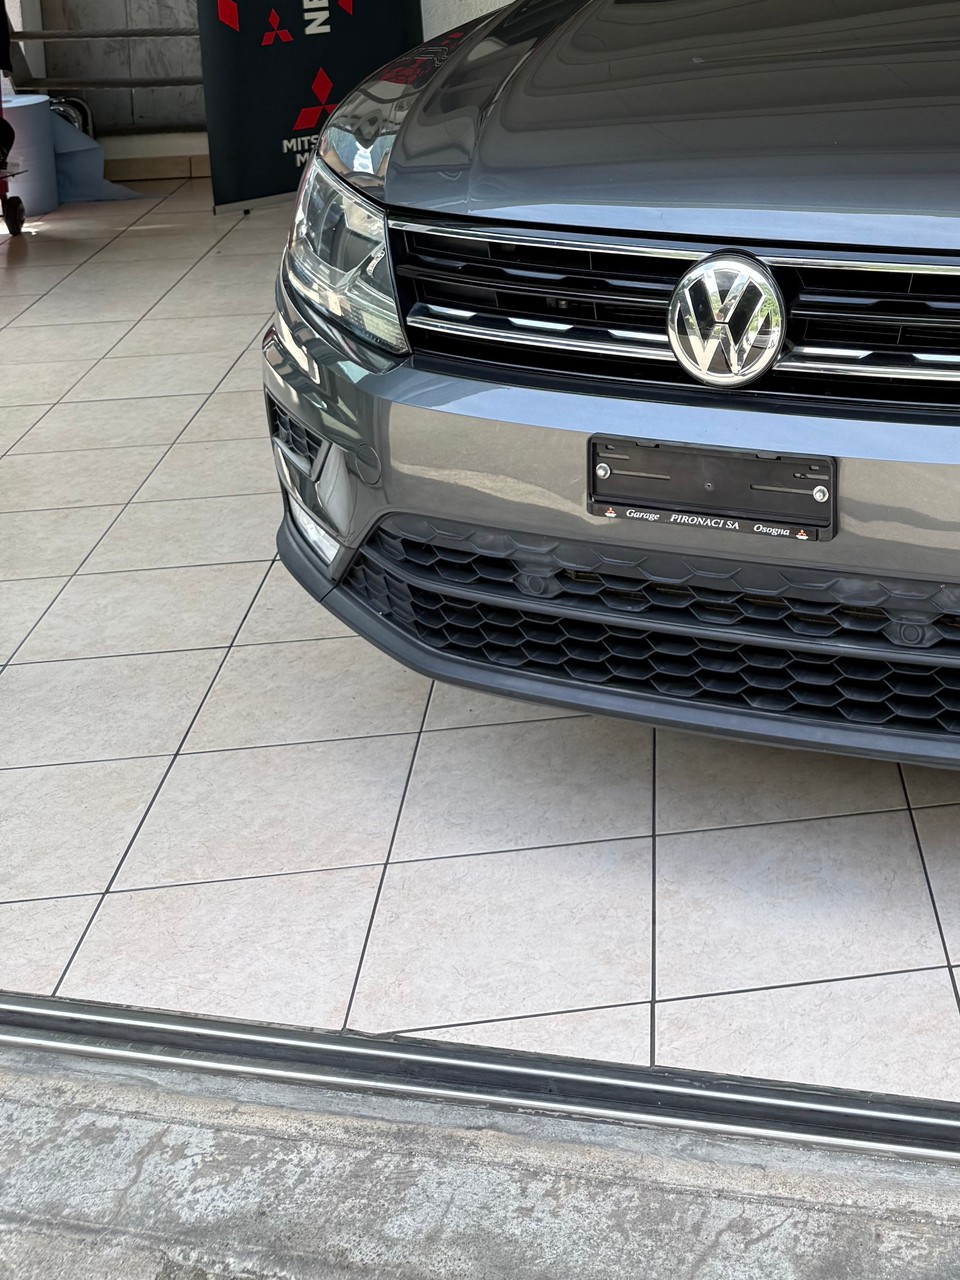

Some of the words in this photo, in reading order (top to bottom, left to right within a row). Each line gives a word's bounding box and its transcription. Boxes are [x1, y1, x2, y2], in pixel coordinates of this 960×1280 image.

[625, 509, 660, 521] Garage
[670, 514, 724, 528] PIRONACI
[725, 520, 740, 530] SA
[753, 524, 790, 537] Osogna
